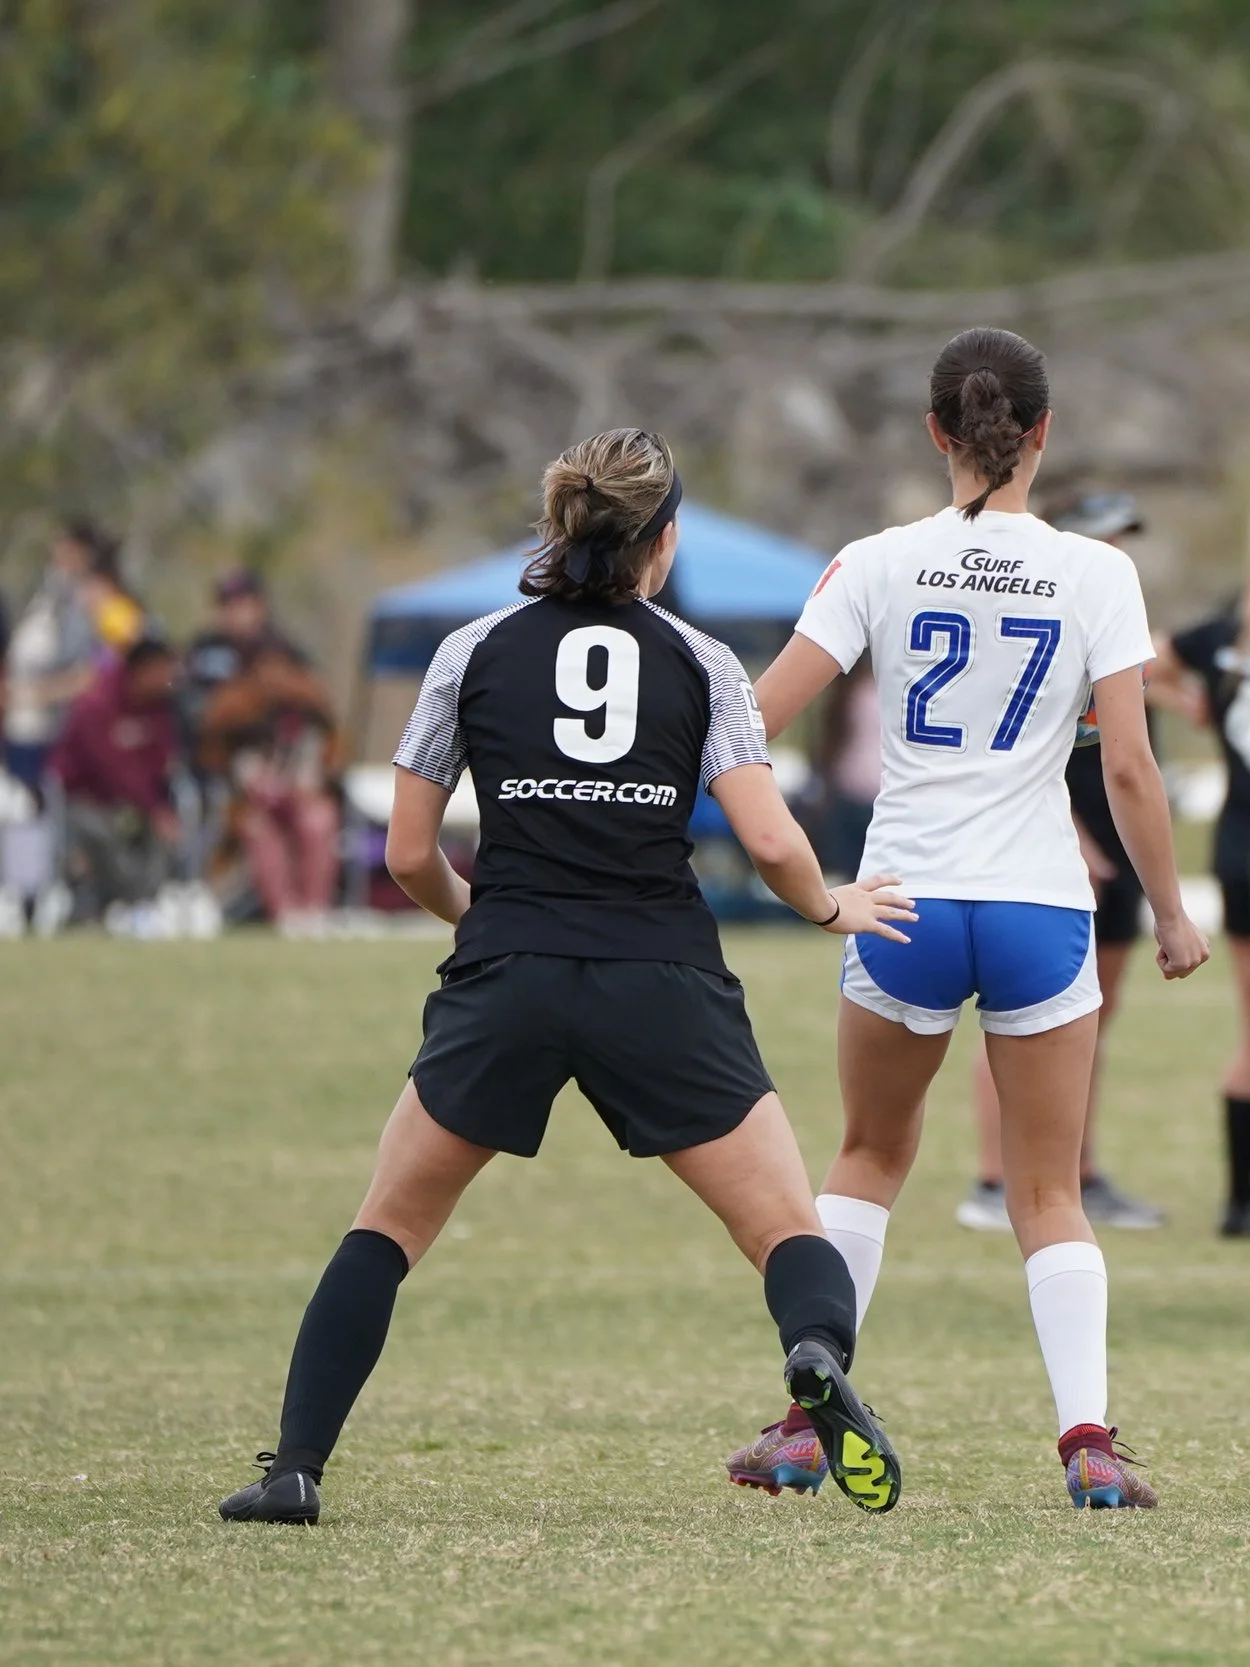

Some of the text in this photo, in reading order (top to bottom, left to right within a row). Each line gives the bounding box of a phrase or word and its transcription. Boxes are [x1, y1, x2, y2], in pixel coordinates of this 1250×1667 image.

[961, 553, 1024, 574] SURF
[916, 569, 1057, 598] LOS ANGELES
[553, 625, 640, 763] 9
[905, 610, 1063, 752] 27
[498, 778, 678, 807] SOCCER.COM
